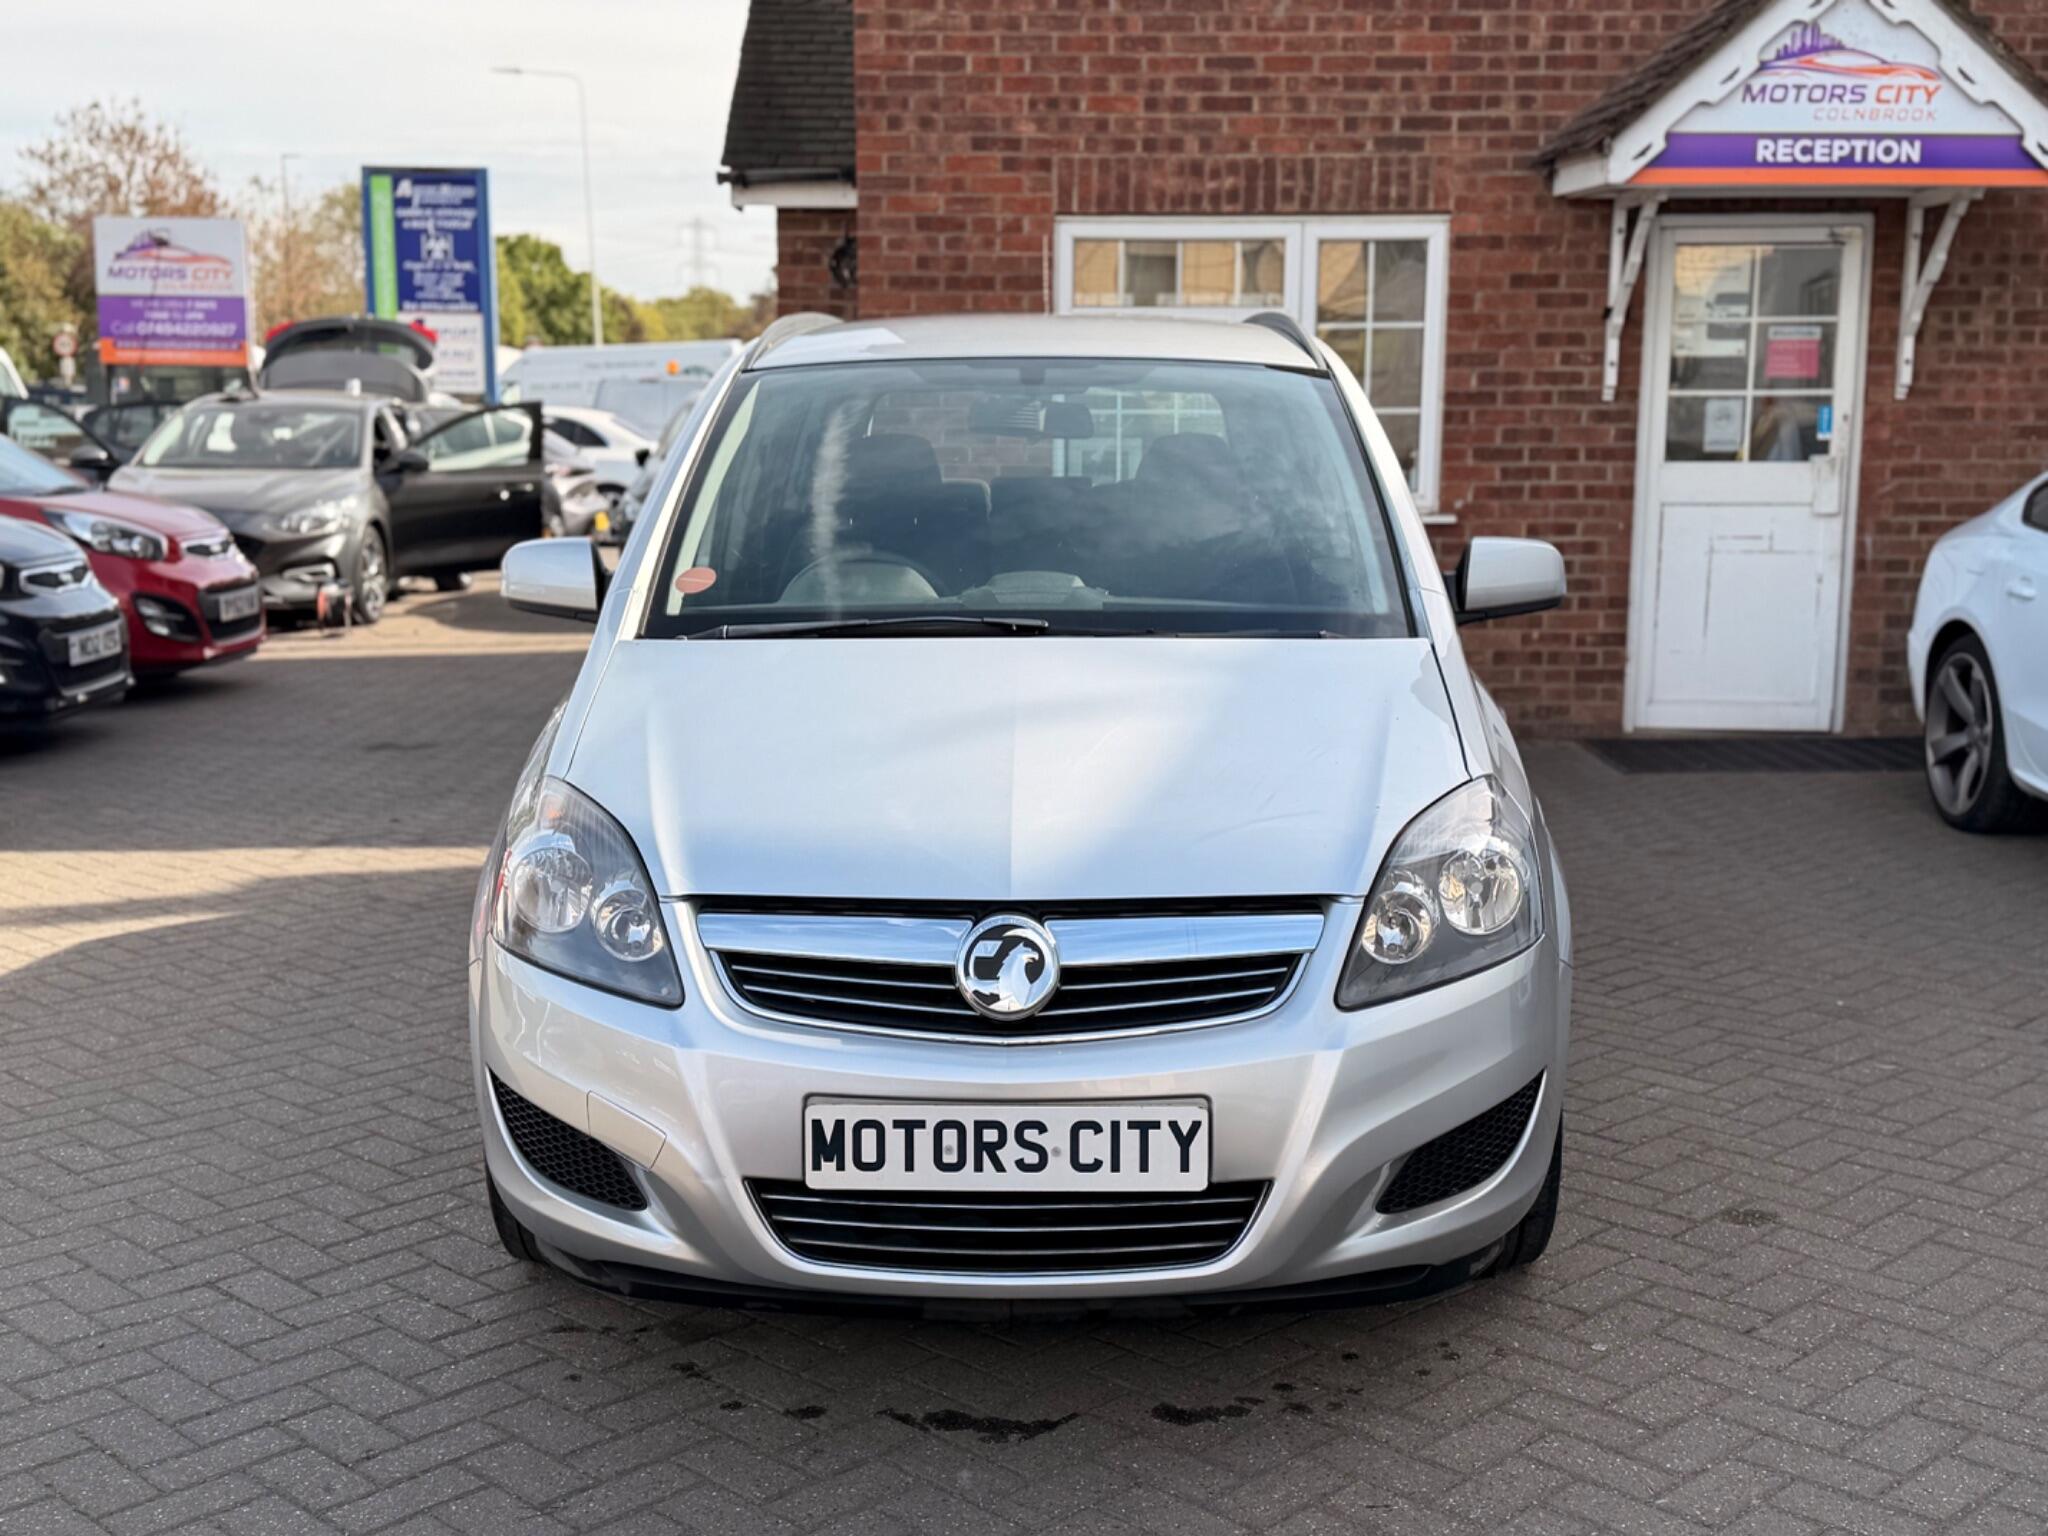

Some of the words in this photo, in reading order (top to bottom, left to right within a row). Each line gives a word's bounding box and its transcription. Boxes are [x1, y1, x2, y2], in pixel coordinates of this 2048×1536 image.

[1741, 84, 1868, 104] MOTORS
[1874, 84, 1941, 104] CITY
[1813, 107, 1937, 121] COLNBROOK
[1756, 138, 1922, 164] RECEPTION
[107, 266, 187, 280] MOTORS
[192, 267, 232, 281] CITY
[811, 1119, 1049, 1174] MOTORS
[1069, 1119, 1202, 1174] CITY
